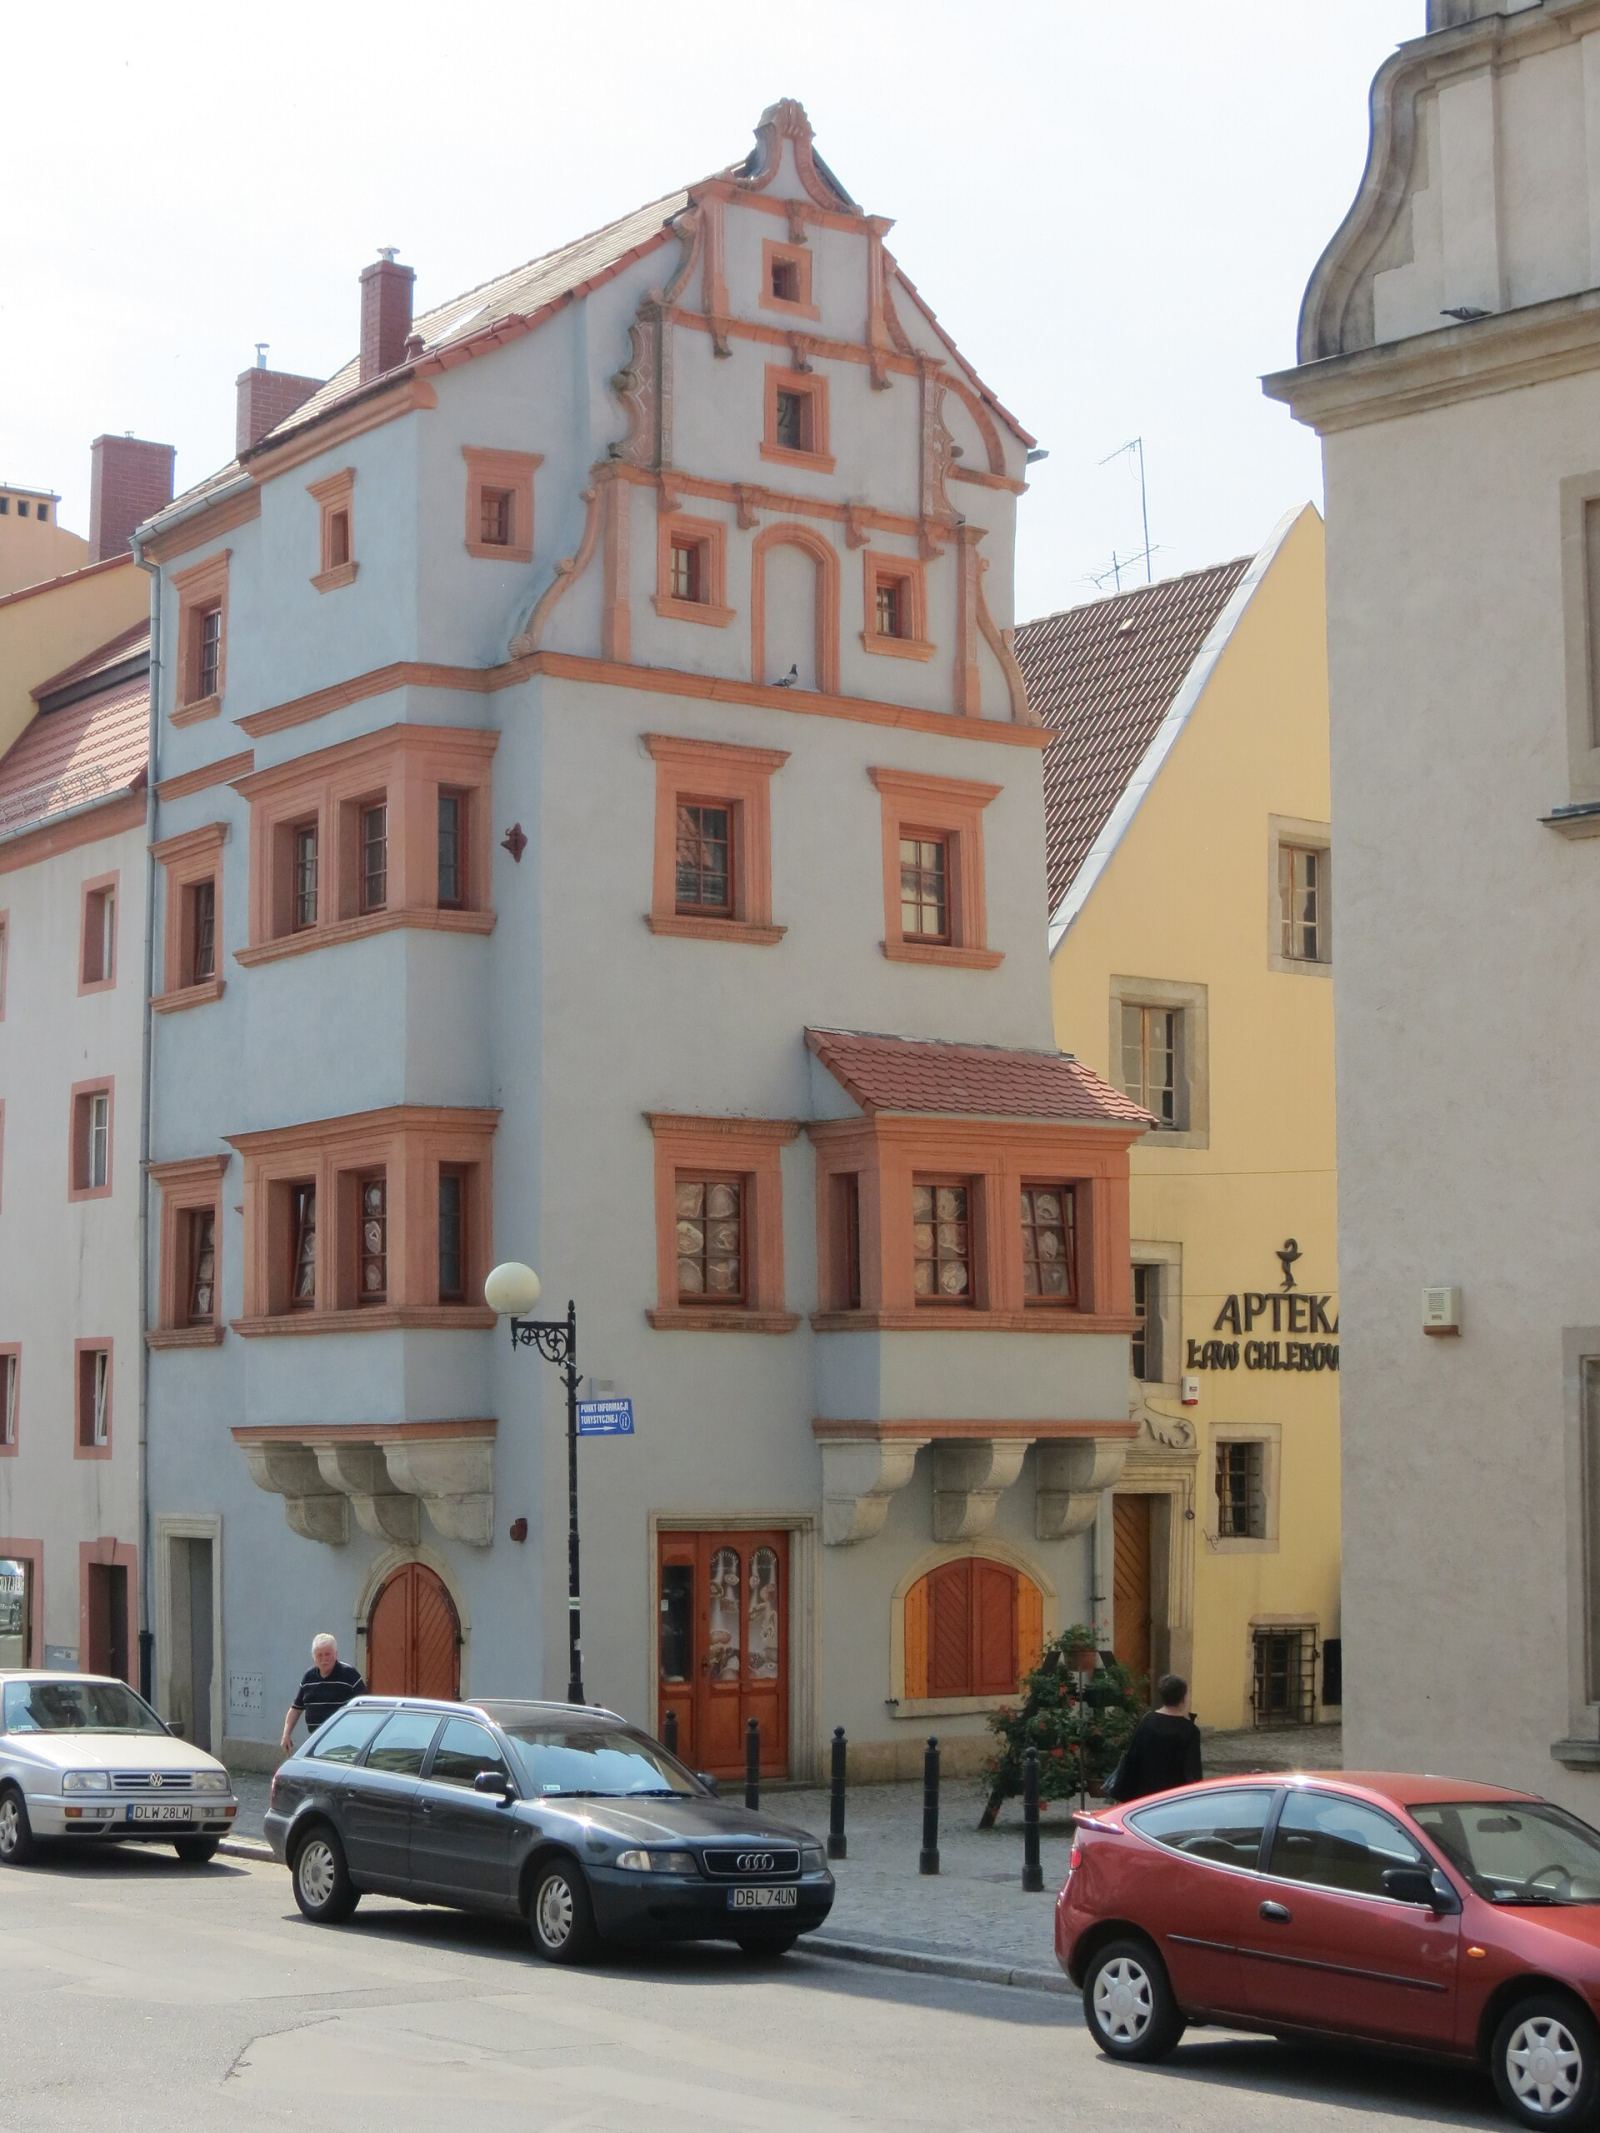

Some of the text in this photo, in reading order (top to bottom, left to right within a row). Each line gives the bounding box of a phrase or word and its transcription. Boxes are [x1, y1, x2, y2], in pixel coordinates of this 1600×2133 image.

[1213, 1292, 1339, 1335] APTEK
[581, 1402, 629, 1413] PUNKT INFORMACJI
[581, 1414, 618, 1424] TURYSTYCZNEJ
[135, 1807, 190, 1819] DLW 28LM
[736, 1889, 796, 1905] DBL 74UN
